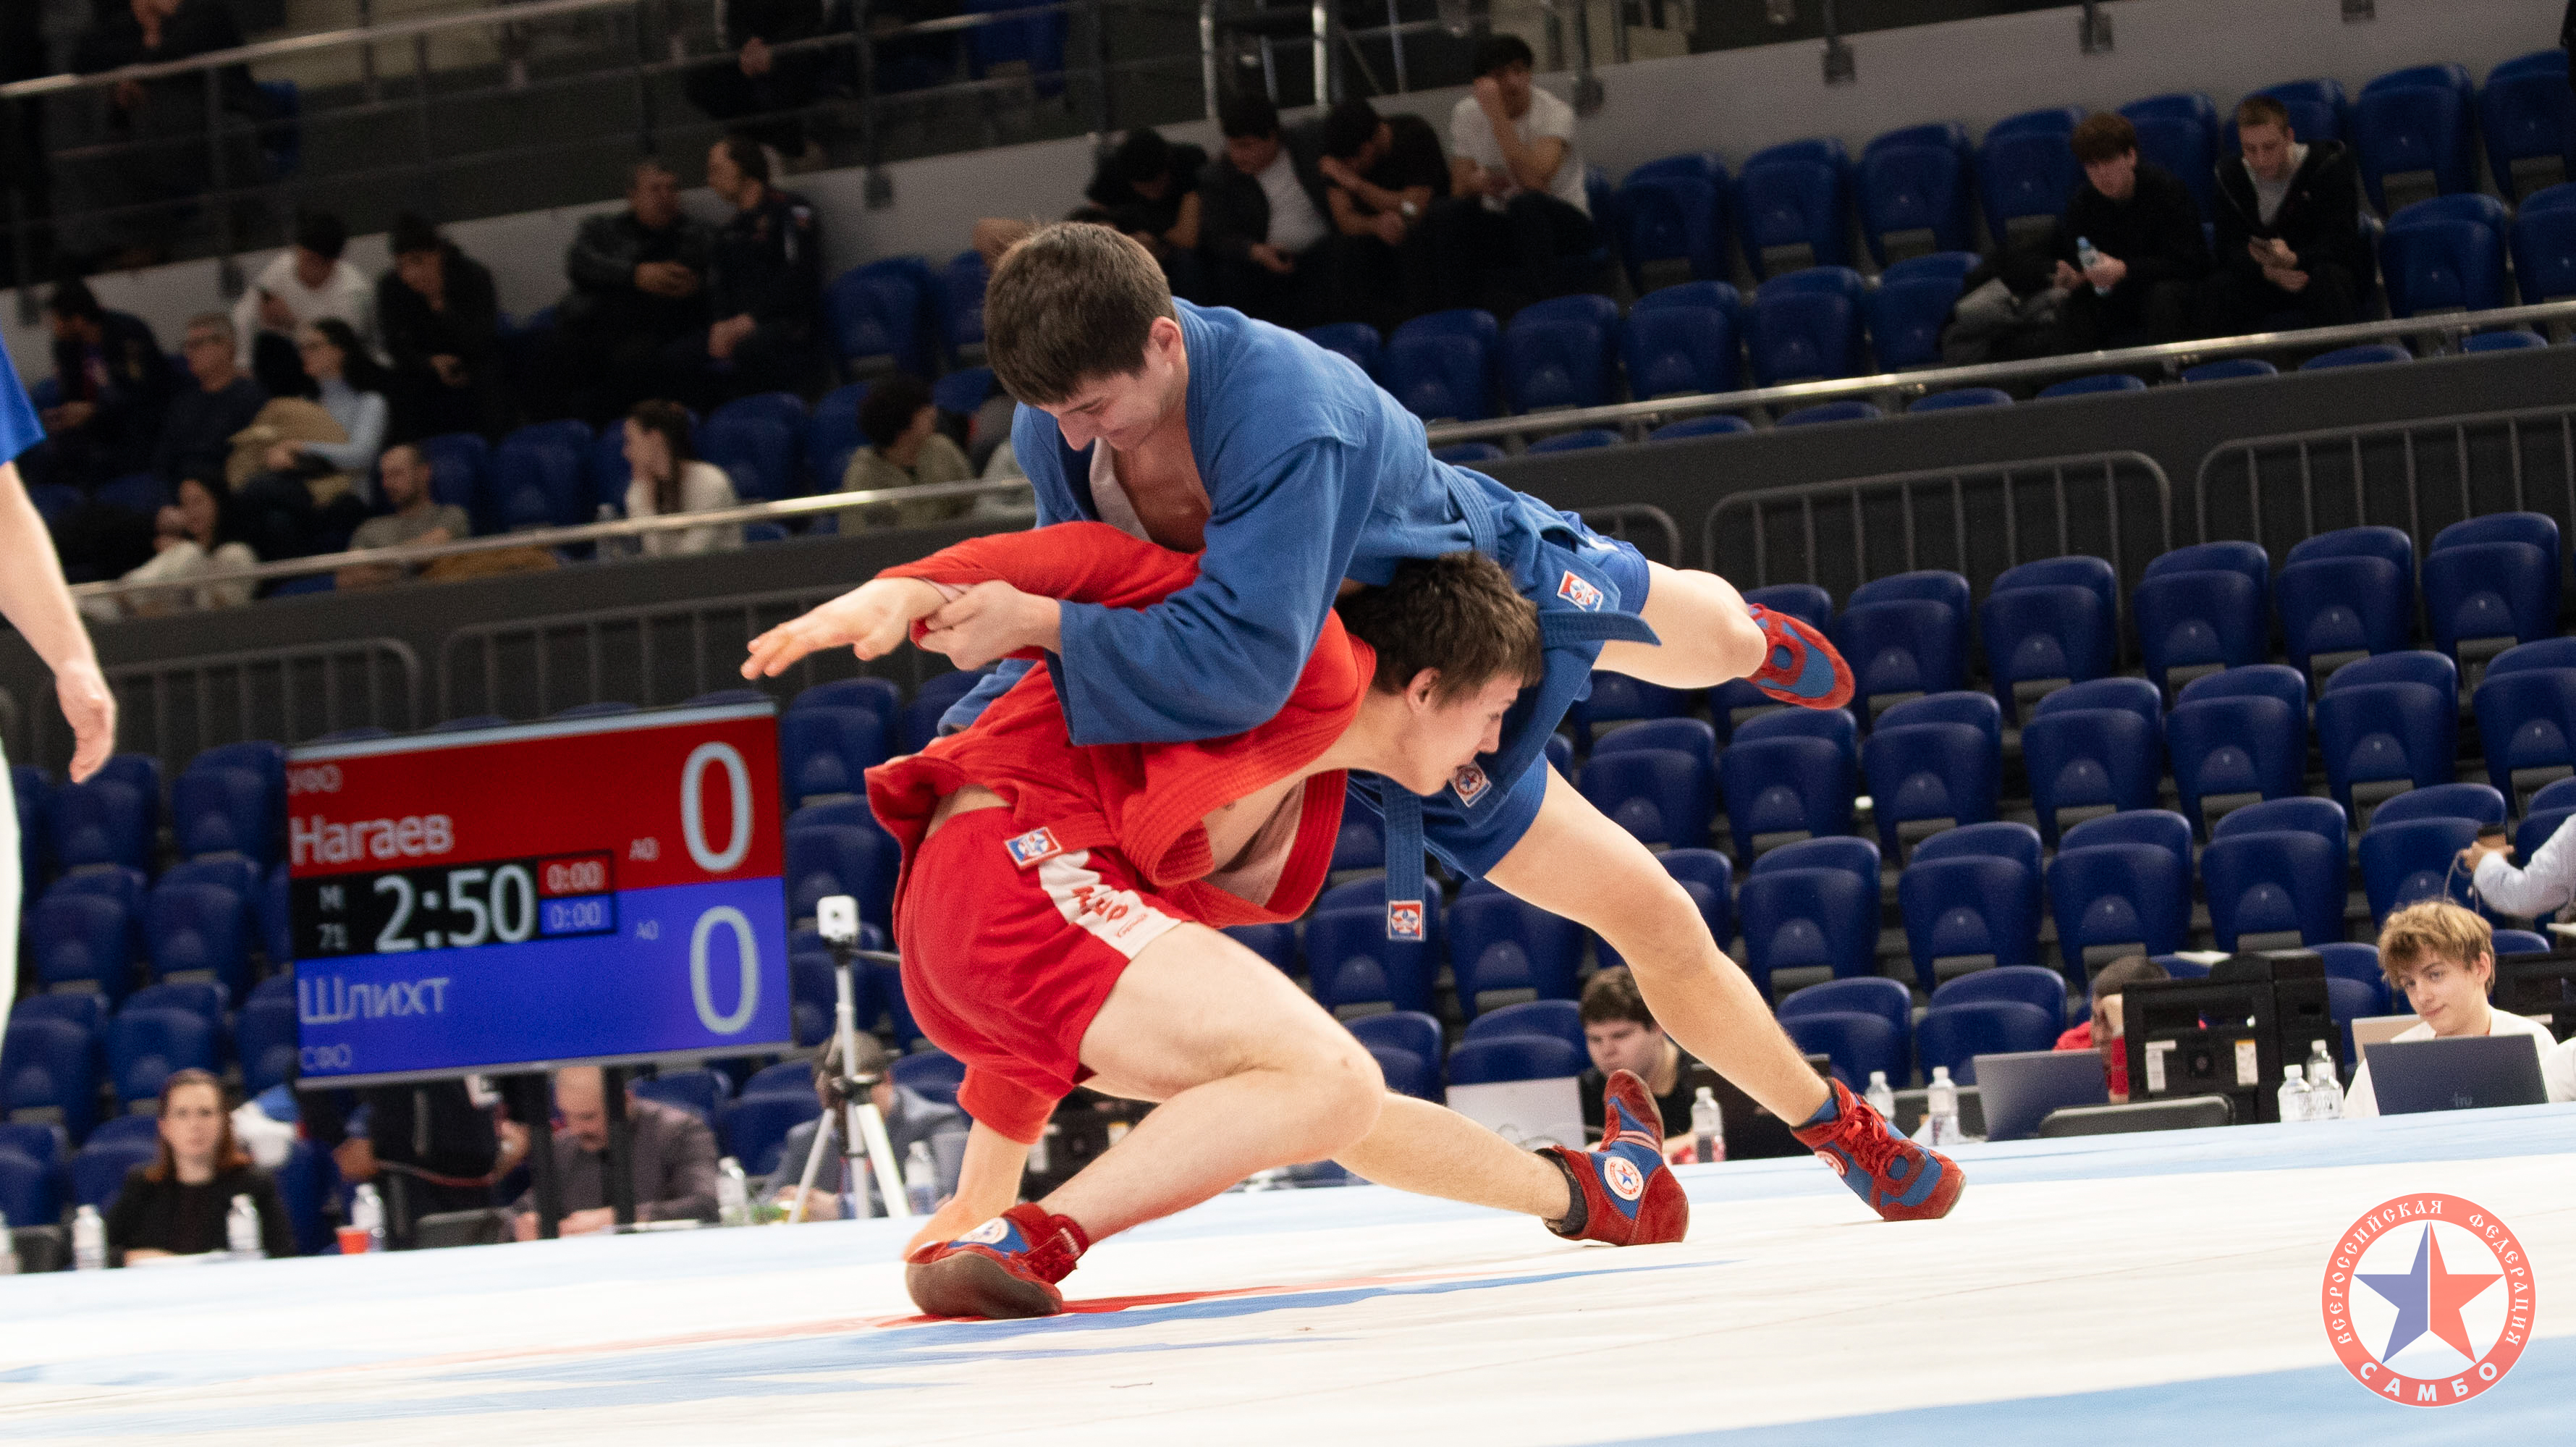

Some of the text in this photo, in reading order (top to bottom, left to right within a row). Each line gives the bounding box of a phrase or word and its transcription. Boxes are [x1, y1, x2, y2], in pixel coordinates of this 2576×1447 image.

[681, 741, 753, 873] 0
[290, 814, 455, 865] Нагаев
[546, 861, 606, 893] 0:00
[373, 864, 537, 954] 2:50
[550, 901, 601, 930] 0:00
[689, 905, 761, 1035] 0
[297, 976, 450, 1025] Шлихт
